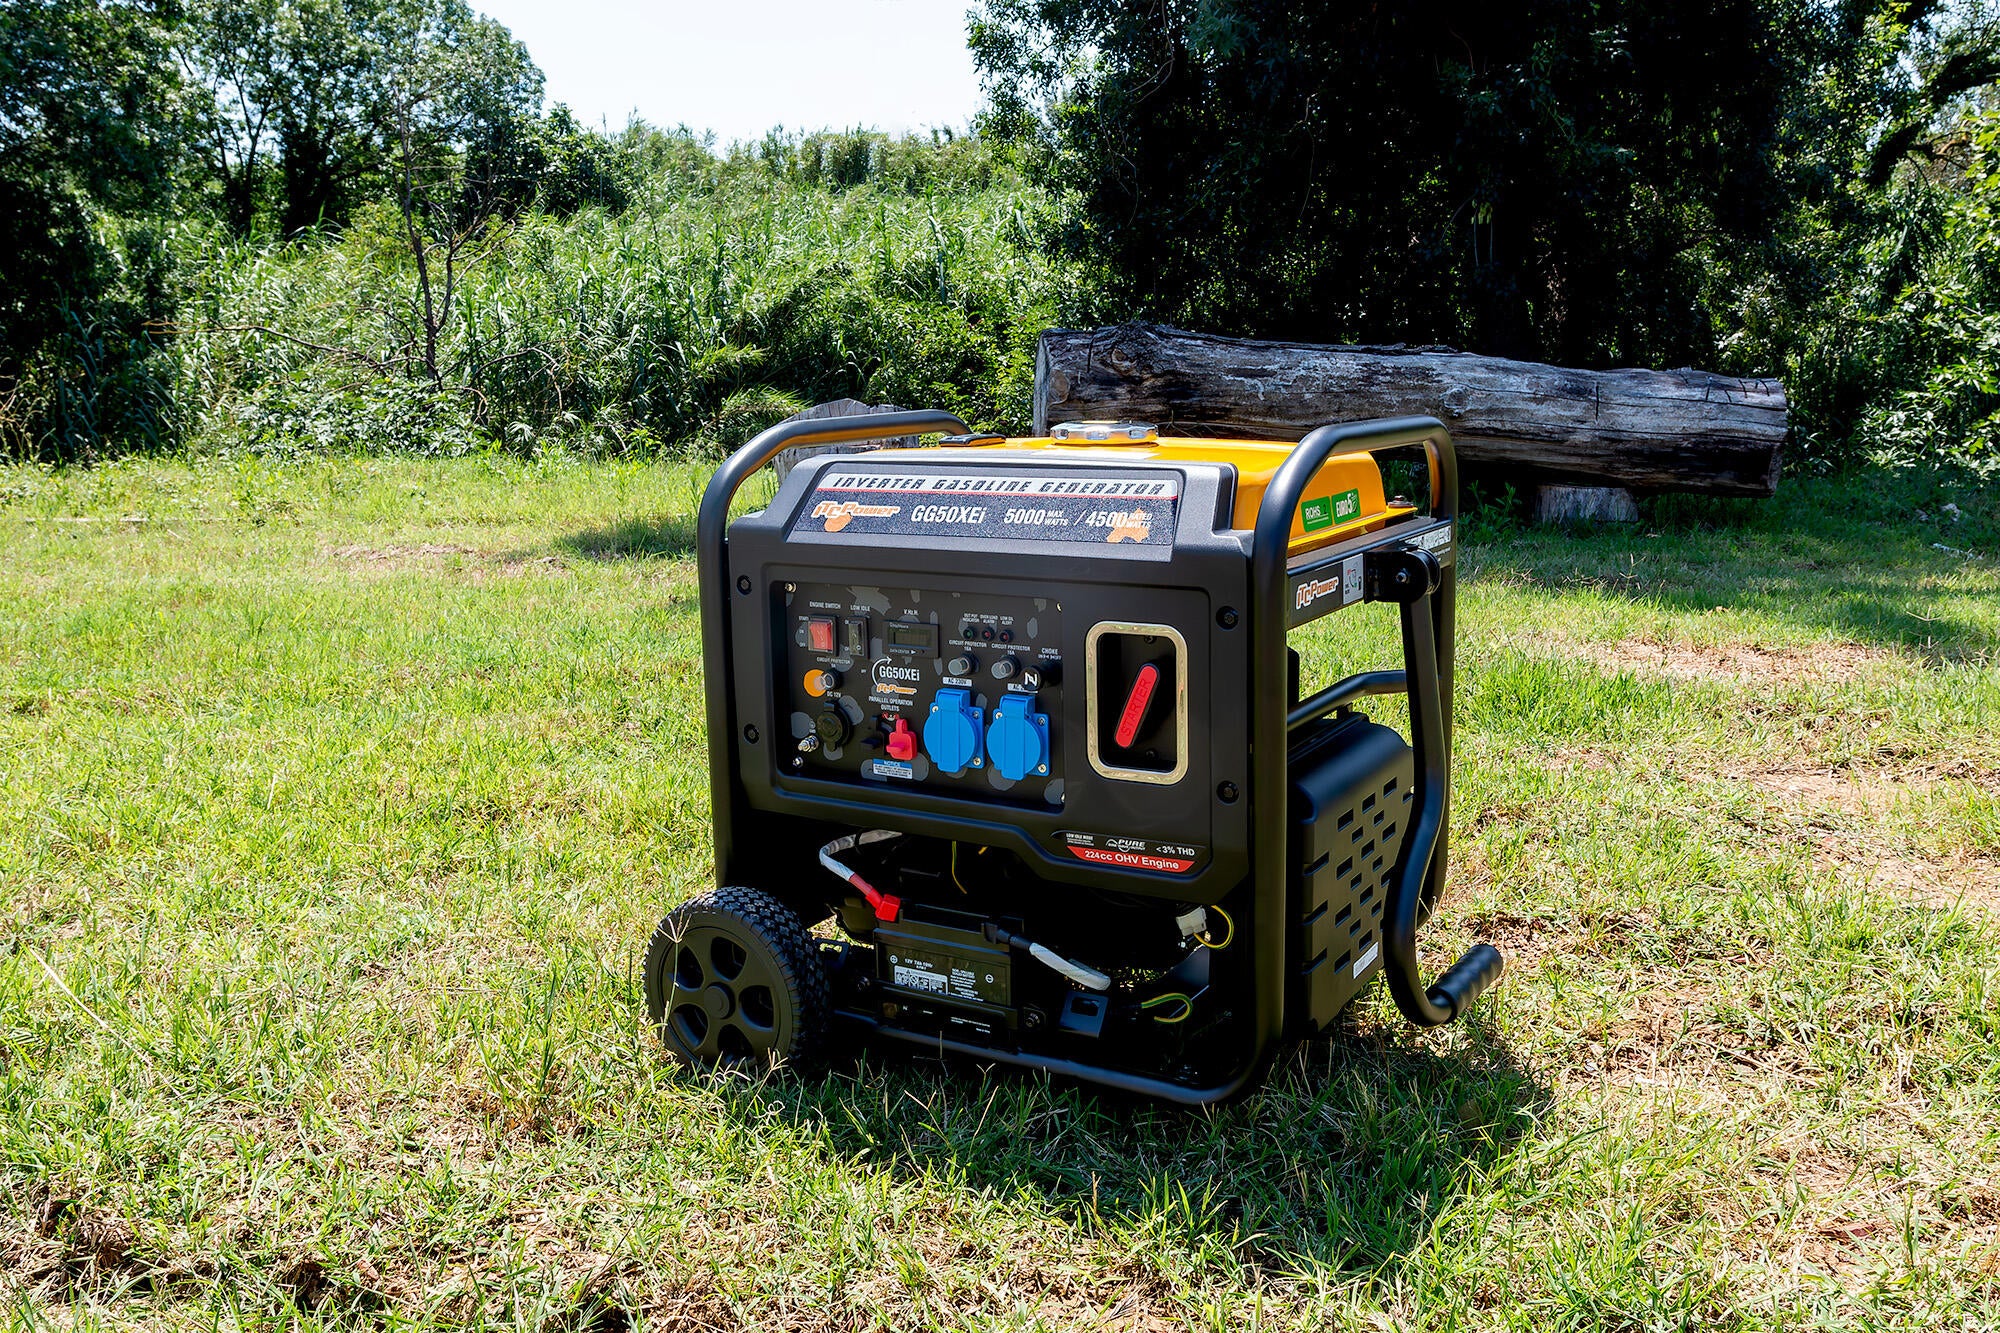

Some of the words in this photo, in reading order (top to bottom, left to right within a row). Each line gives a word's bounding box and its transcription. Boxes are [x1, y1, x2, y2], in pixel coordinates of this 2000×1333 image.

[832, 477, 926, 490] INVERTER
[932, 479, 1032, 493] GASOLINE
[1038, 481, 1165, 495] GENERATOR
[910, 505, 987, 524] GG50XEi
[1003, 508, 1046, 525] 5000
[1046, 510, 1064, 518] MAX
[1127, 513, 1153, 521] RATED
[1305, 506, 1321, 520] ROHS
[1044, 517, 1069, 526] WATTS
[1125, 520, 1152, 528] WATTS
[879, 665, 920, 682] GG50XEi
[1120, 678, 1151, 737] STARTER
[1118, 839, 1146, 848] PURE
[1176, 847, 1195, 856] THD
[1114, 853, 1138, 864] OHV
[1142, 856, 1179, 870] Engine
